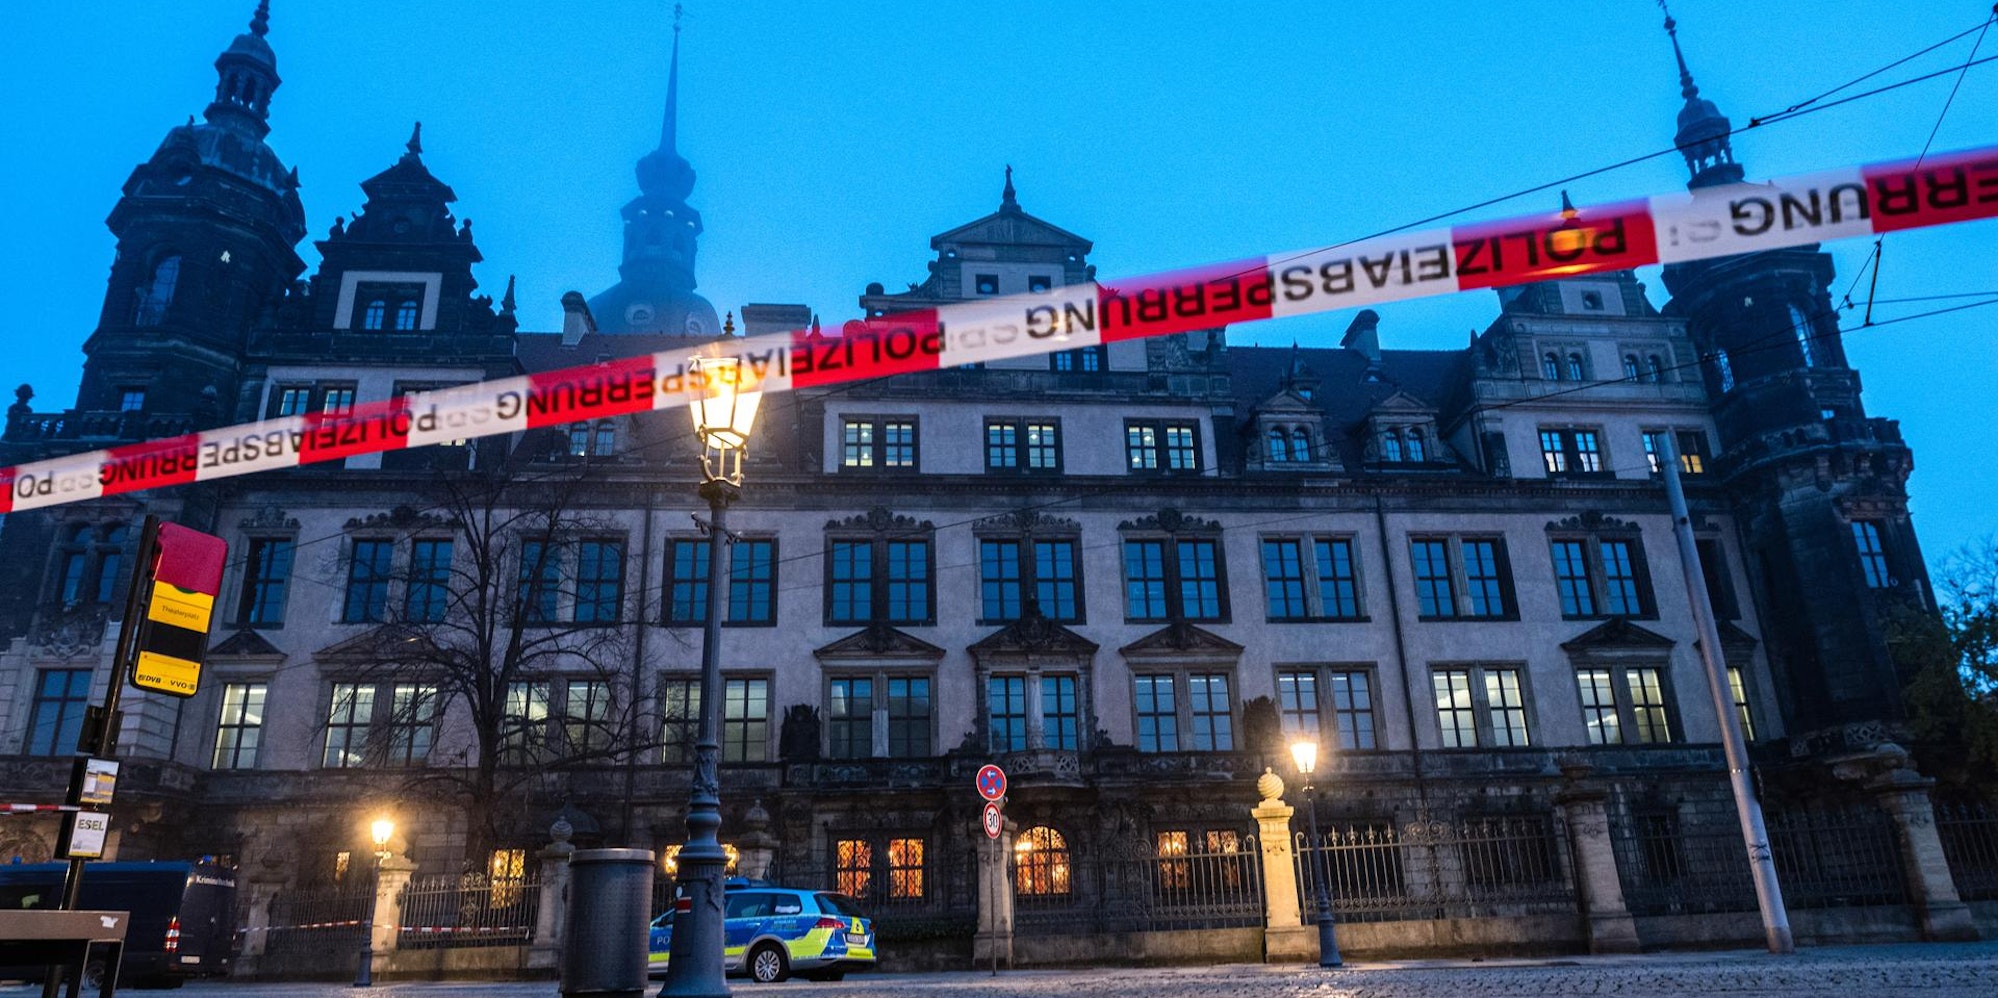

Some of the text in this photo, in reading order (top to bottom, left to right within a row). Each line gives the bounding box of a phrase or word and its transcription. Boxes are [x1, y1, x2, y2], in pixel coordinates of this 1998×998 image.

[1025, 217, 1627, 339] POLIZEIABSPERRUNG
[98, 402, 438, 486] POLIZEIABSPERRUNG
[78, 819, 105, 831] ESEL
[987, 812, 998, 828] 30
